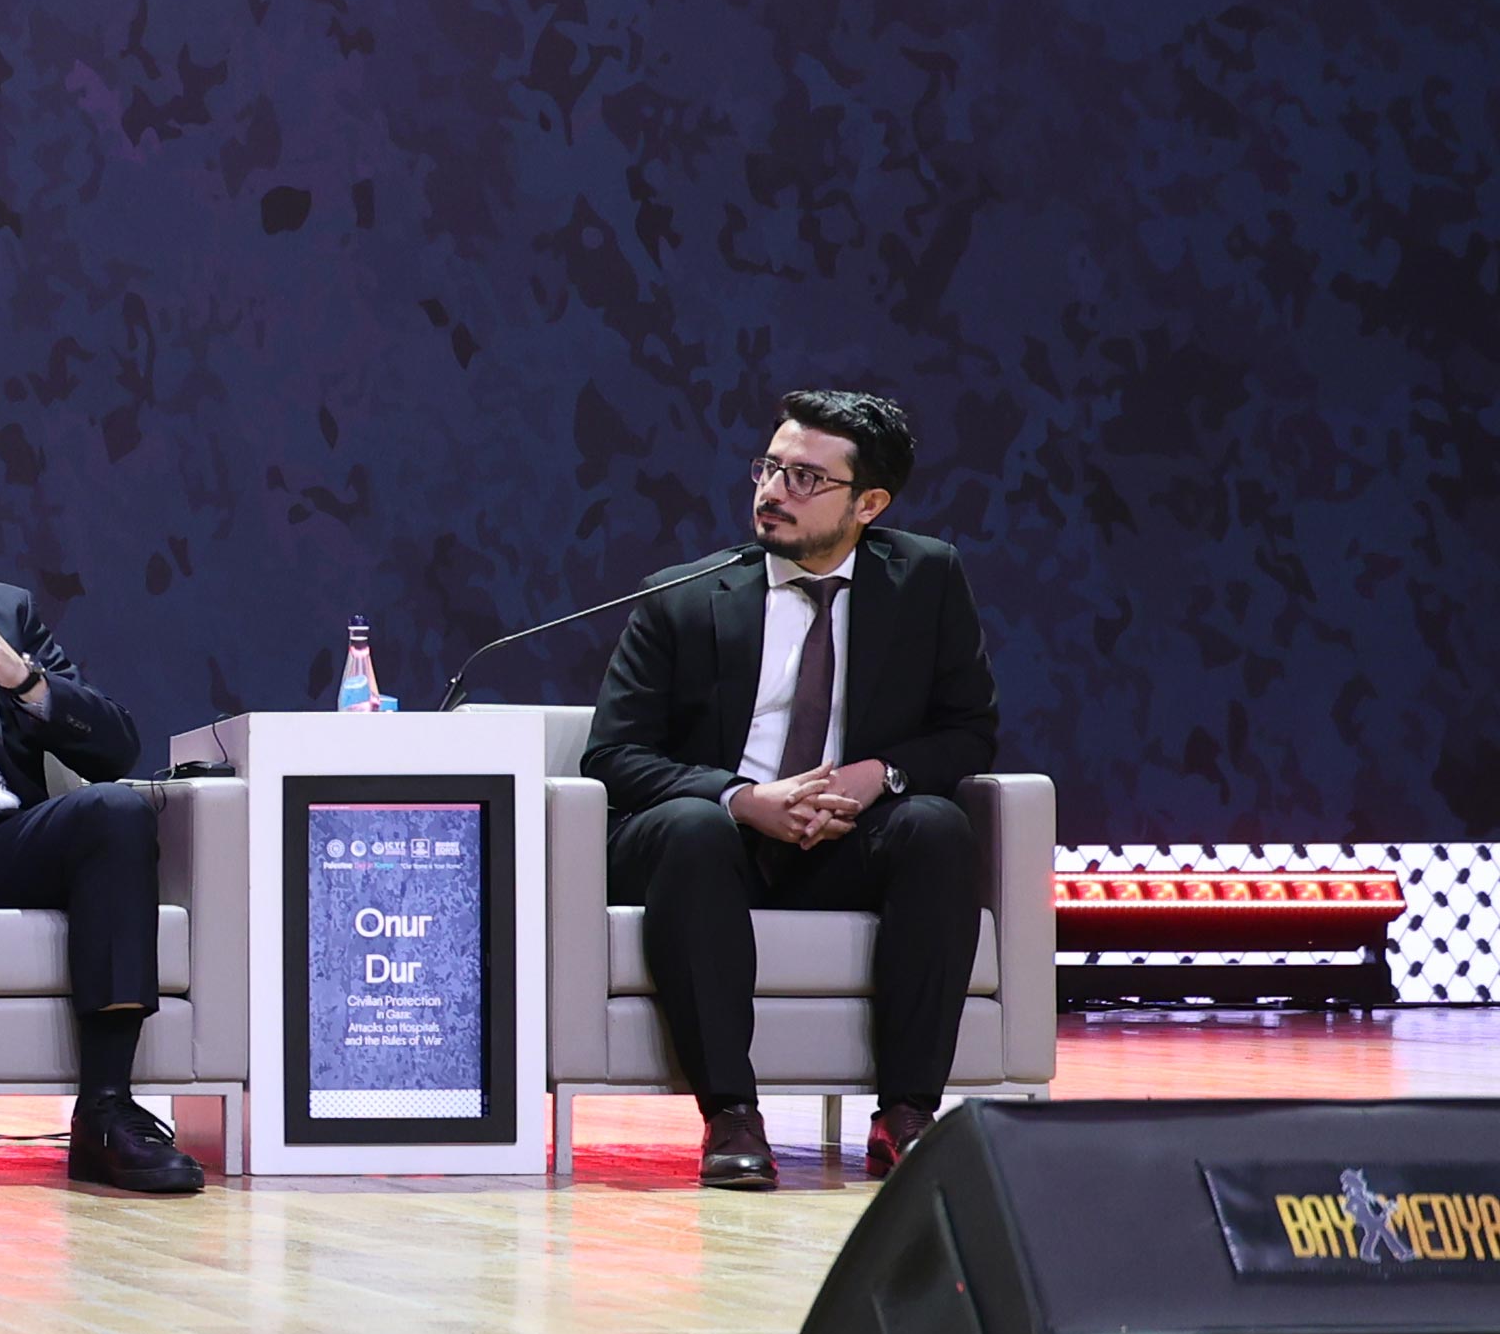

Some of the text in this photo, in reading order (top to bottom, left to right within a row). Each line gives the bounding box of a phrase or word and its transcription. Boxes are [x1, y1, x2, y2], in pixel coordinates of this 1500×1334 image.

[354, 907, 432, 938] Onur
[366, 953, 422, 984] Dur
[347, 995, 441, 1007] Civilian Protection
[376, 1009, 385, 1019] in
[348, 1022, 440, 1034] Attacks on Hospitals
[344, 1035, 443, 1046] and the Rules of War
[1274, 1194, 1360, 1259] BAY
